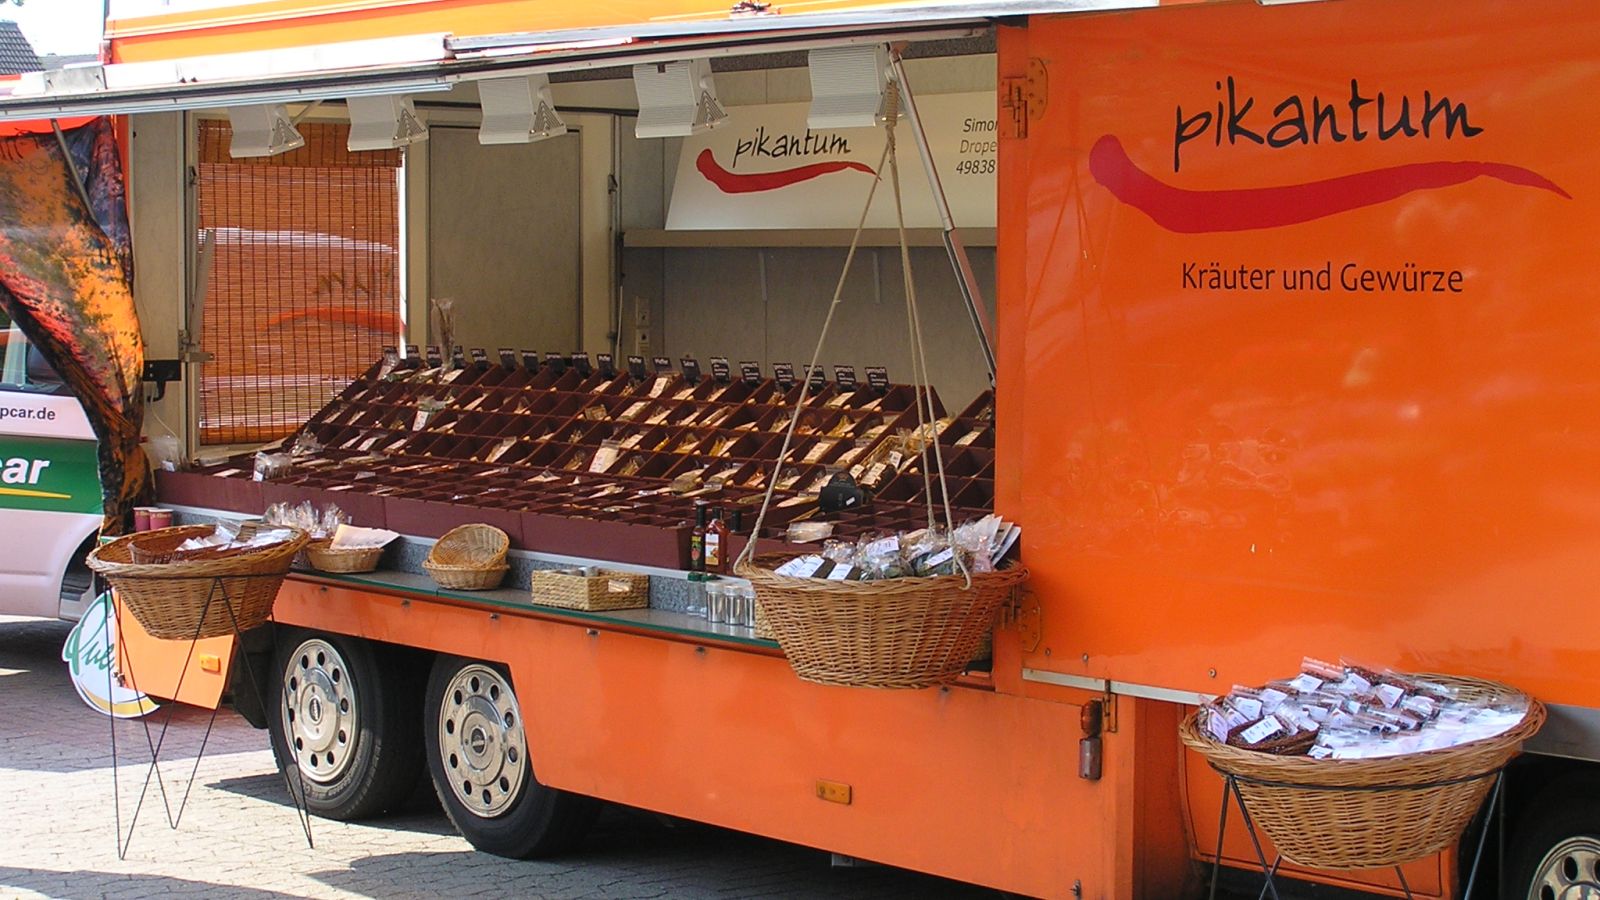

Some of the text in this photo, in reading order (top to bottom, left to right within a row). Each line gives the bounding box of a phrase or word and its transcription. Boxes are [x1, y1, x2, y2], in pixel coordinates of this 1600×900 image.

[1175, 75, 1484, 172] pikantum
[732, 126, 852, 168] pikantum
[956, 159, 996, 174] 49838
[1182, 261, 1464, 292] Kräuter und Gewürze
[0, 457, 51, 485] ar
